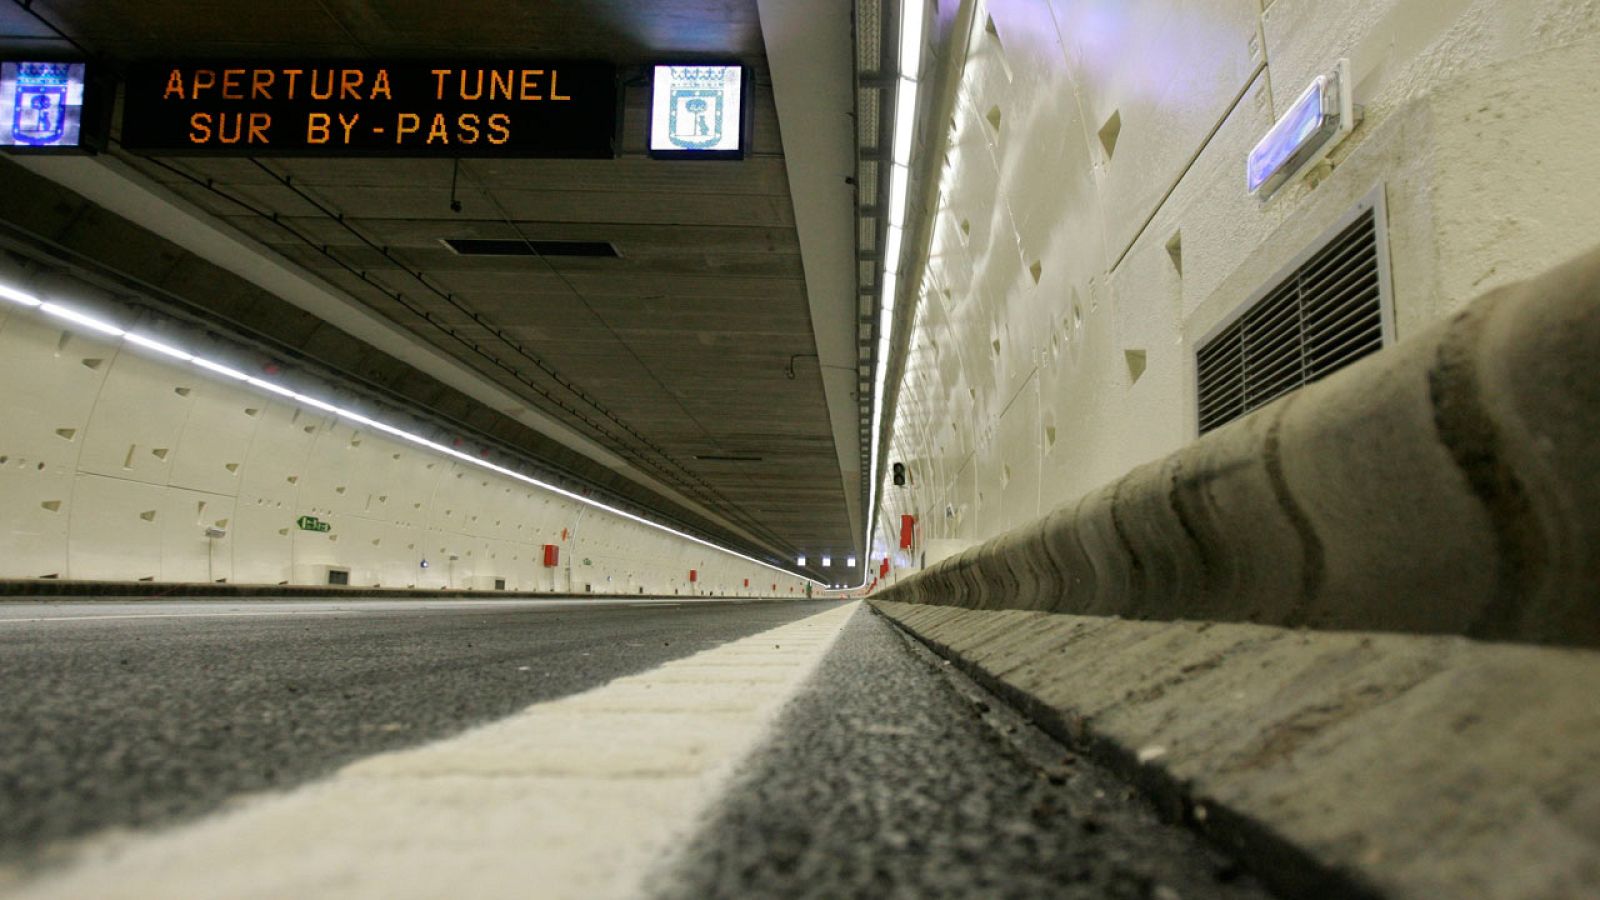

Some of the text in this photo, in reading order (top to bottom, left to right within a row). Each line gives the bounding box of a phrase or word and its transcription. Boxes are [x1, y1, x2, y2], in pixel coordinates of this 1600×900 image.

[163, 69, 571, 101] APERTURA TUNEL
[189, 112, 511, 145] SUR BY-PASS
